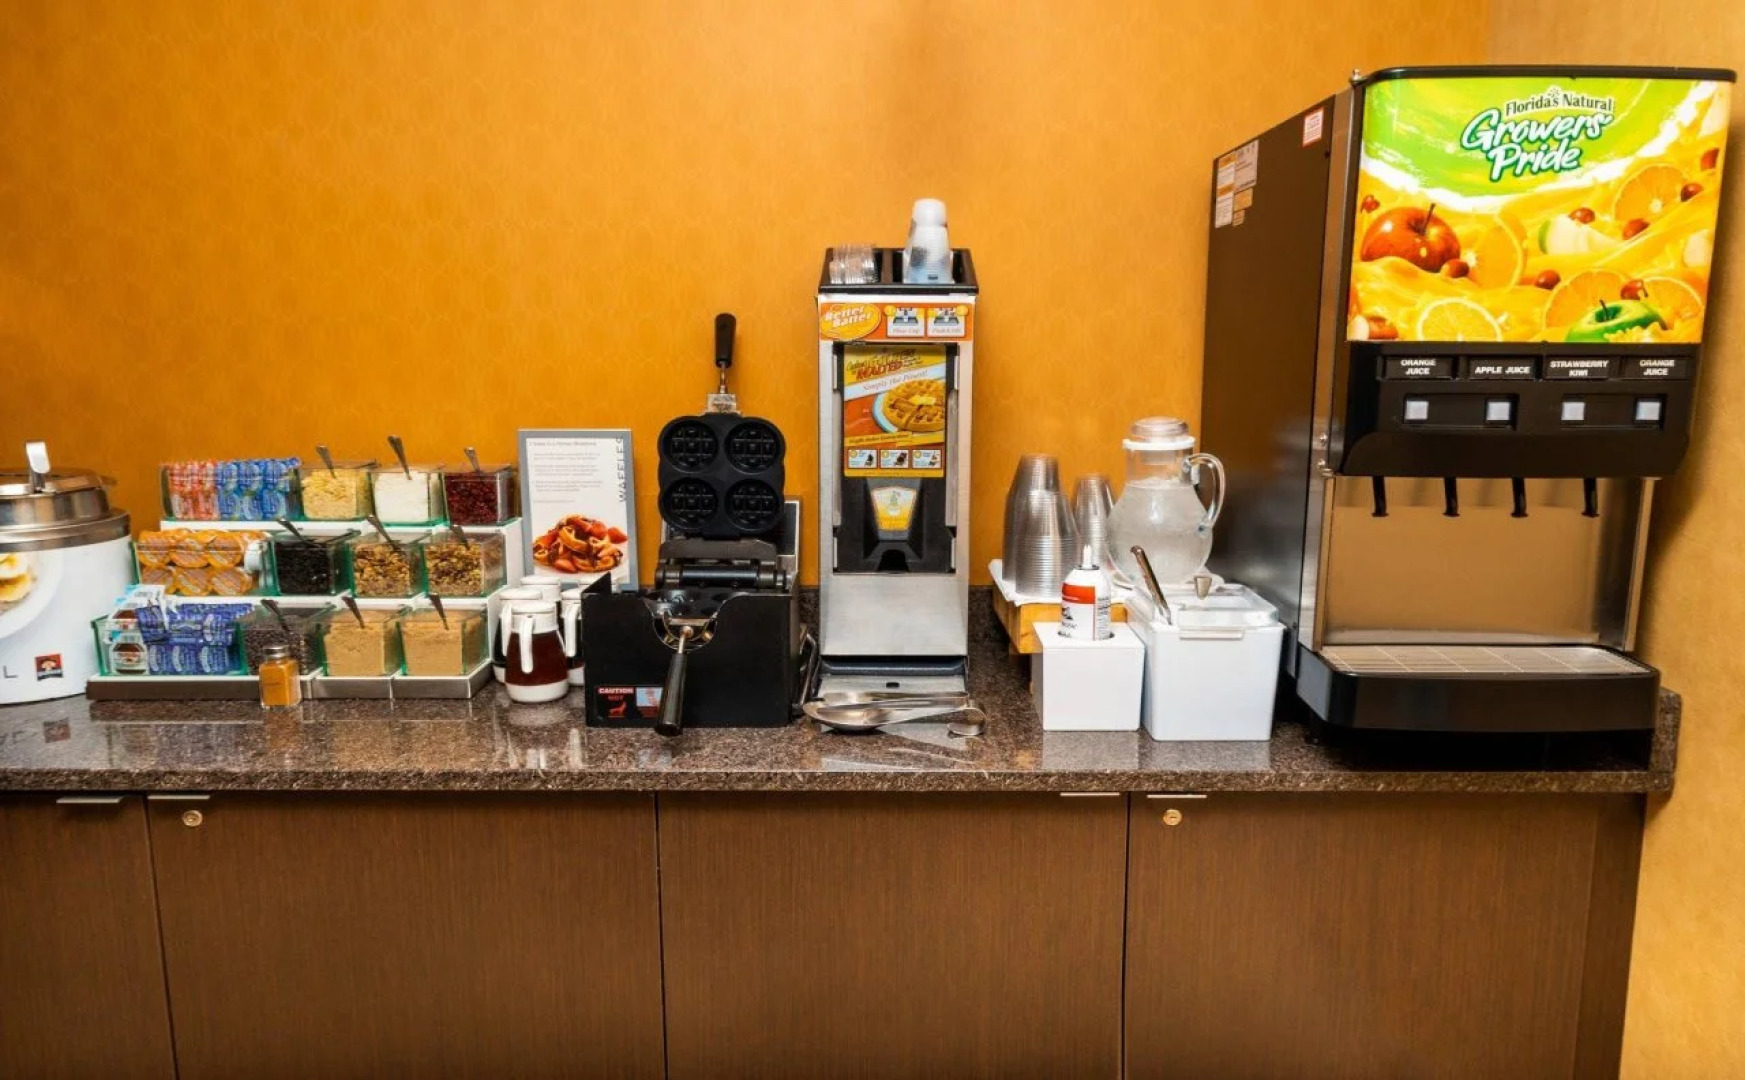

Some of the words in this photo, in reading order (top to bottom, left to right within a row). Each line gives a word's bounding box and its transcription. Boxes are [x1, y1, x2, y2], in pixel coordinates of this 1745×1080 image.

[1505, 93, 1559, 116] Florida's
[1562, 93, 1612, 111] Natural
[1486, 137, 1582, 181] Pride
[1400, 359, 1436, 367] ORANGE
[1549, 360, 1610, 369] STRAWBERRY
[1639, 359, 1675, 367] ORANGE
[1405, 367, 1431, 376] JUICE
[1474, 366, 1503, 375] APPLE
[1504, 366, 1531, 375] JUICE
[1568, 369, 1589, 377] KIWI
[1643, 367, 1668, 376] JUICE
